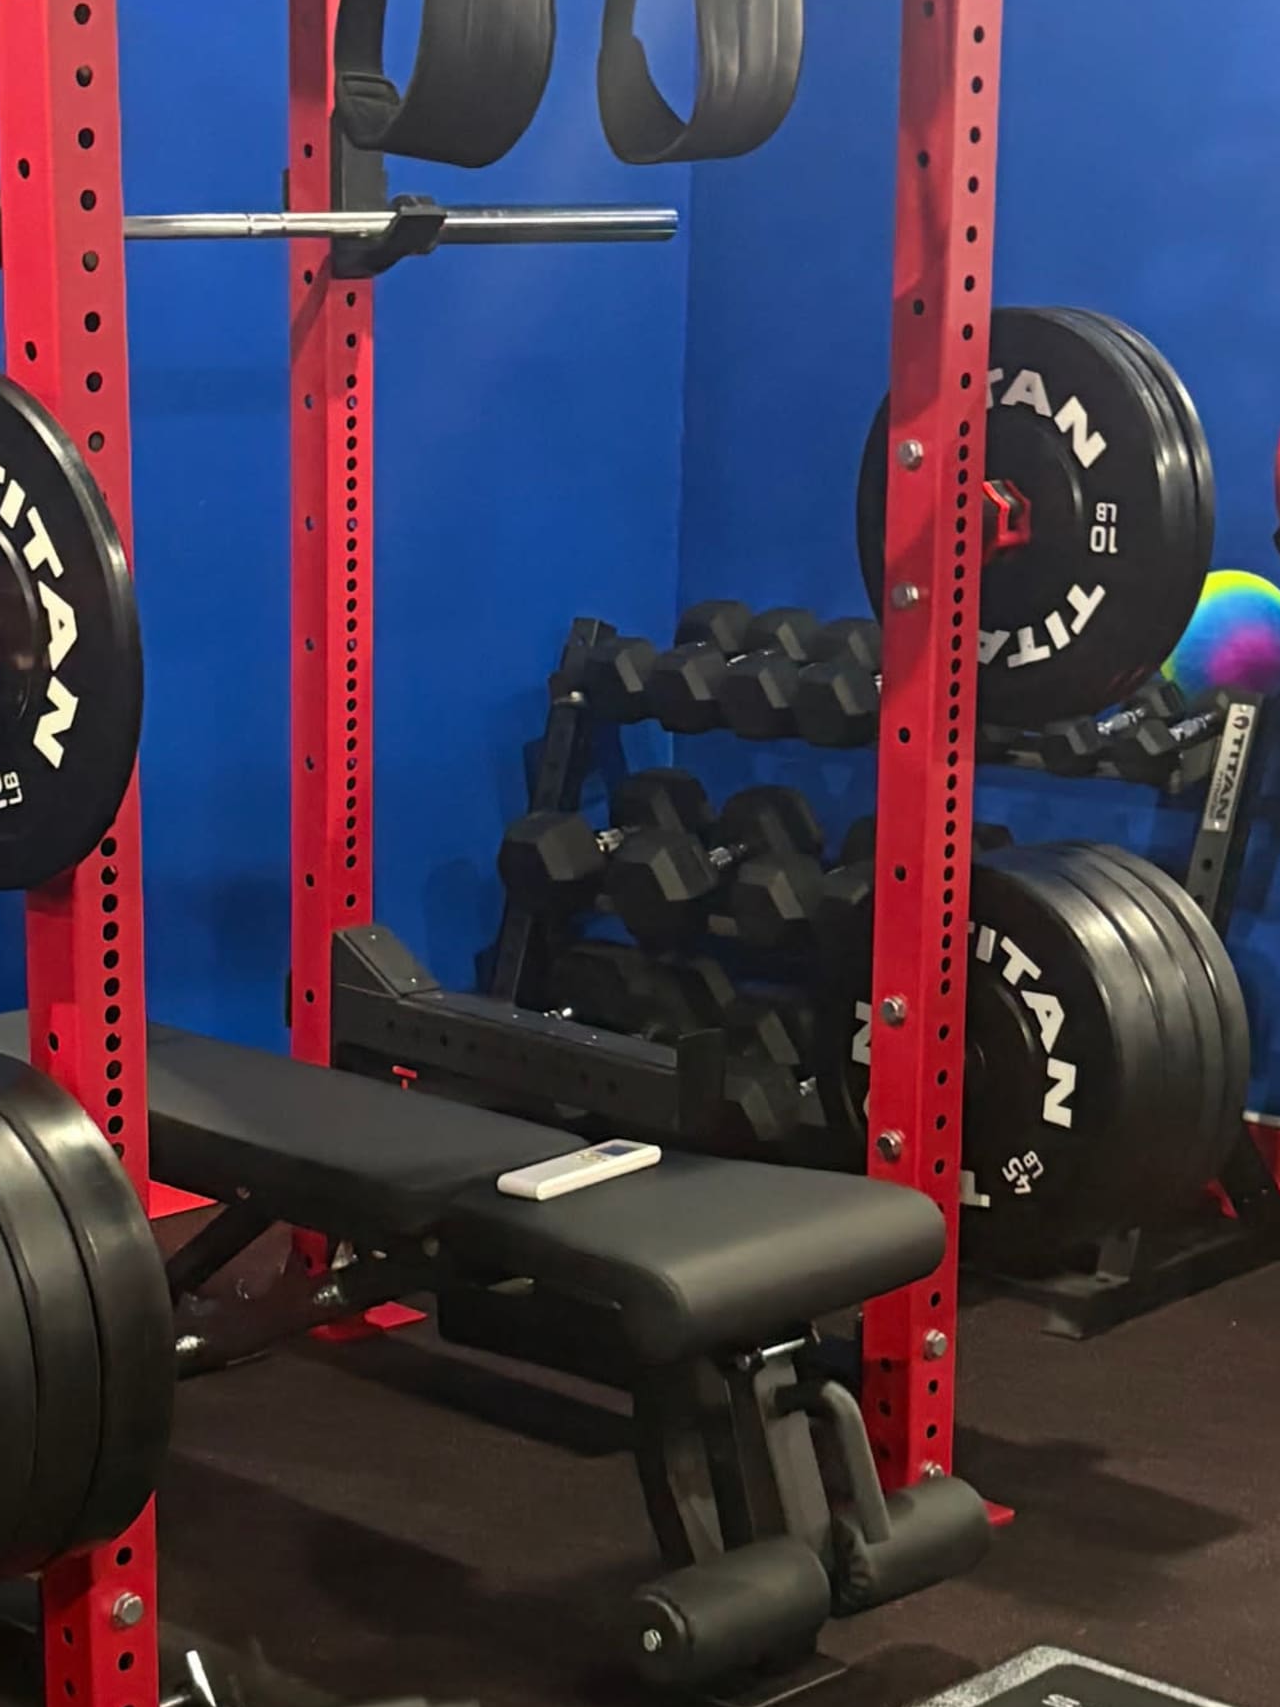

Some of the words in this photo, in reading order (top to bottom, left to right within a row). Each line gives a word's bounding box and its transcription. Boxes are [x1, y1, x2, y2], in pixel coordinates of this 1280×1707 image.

[1095, 501, 1118, 523] LB
[1090, 525, 1119, 555] 10
[976, 583, 1106, 669] TITA
[3, 771, 23, 807] LB
[1215, 734, 1246, 820] TITAN
[966, 920, 1078, 1129] ITAN
[1001, 1156, 1033, 1195] 45
[1022, 1149, 1045, 1179] LB
